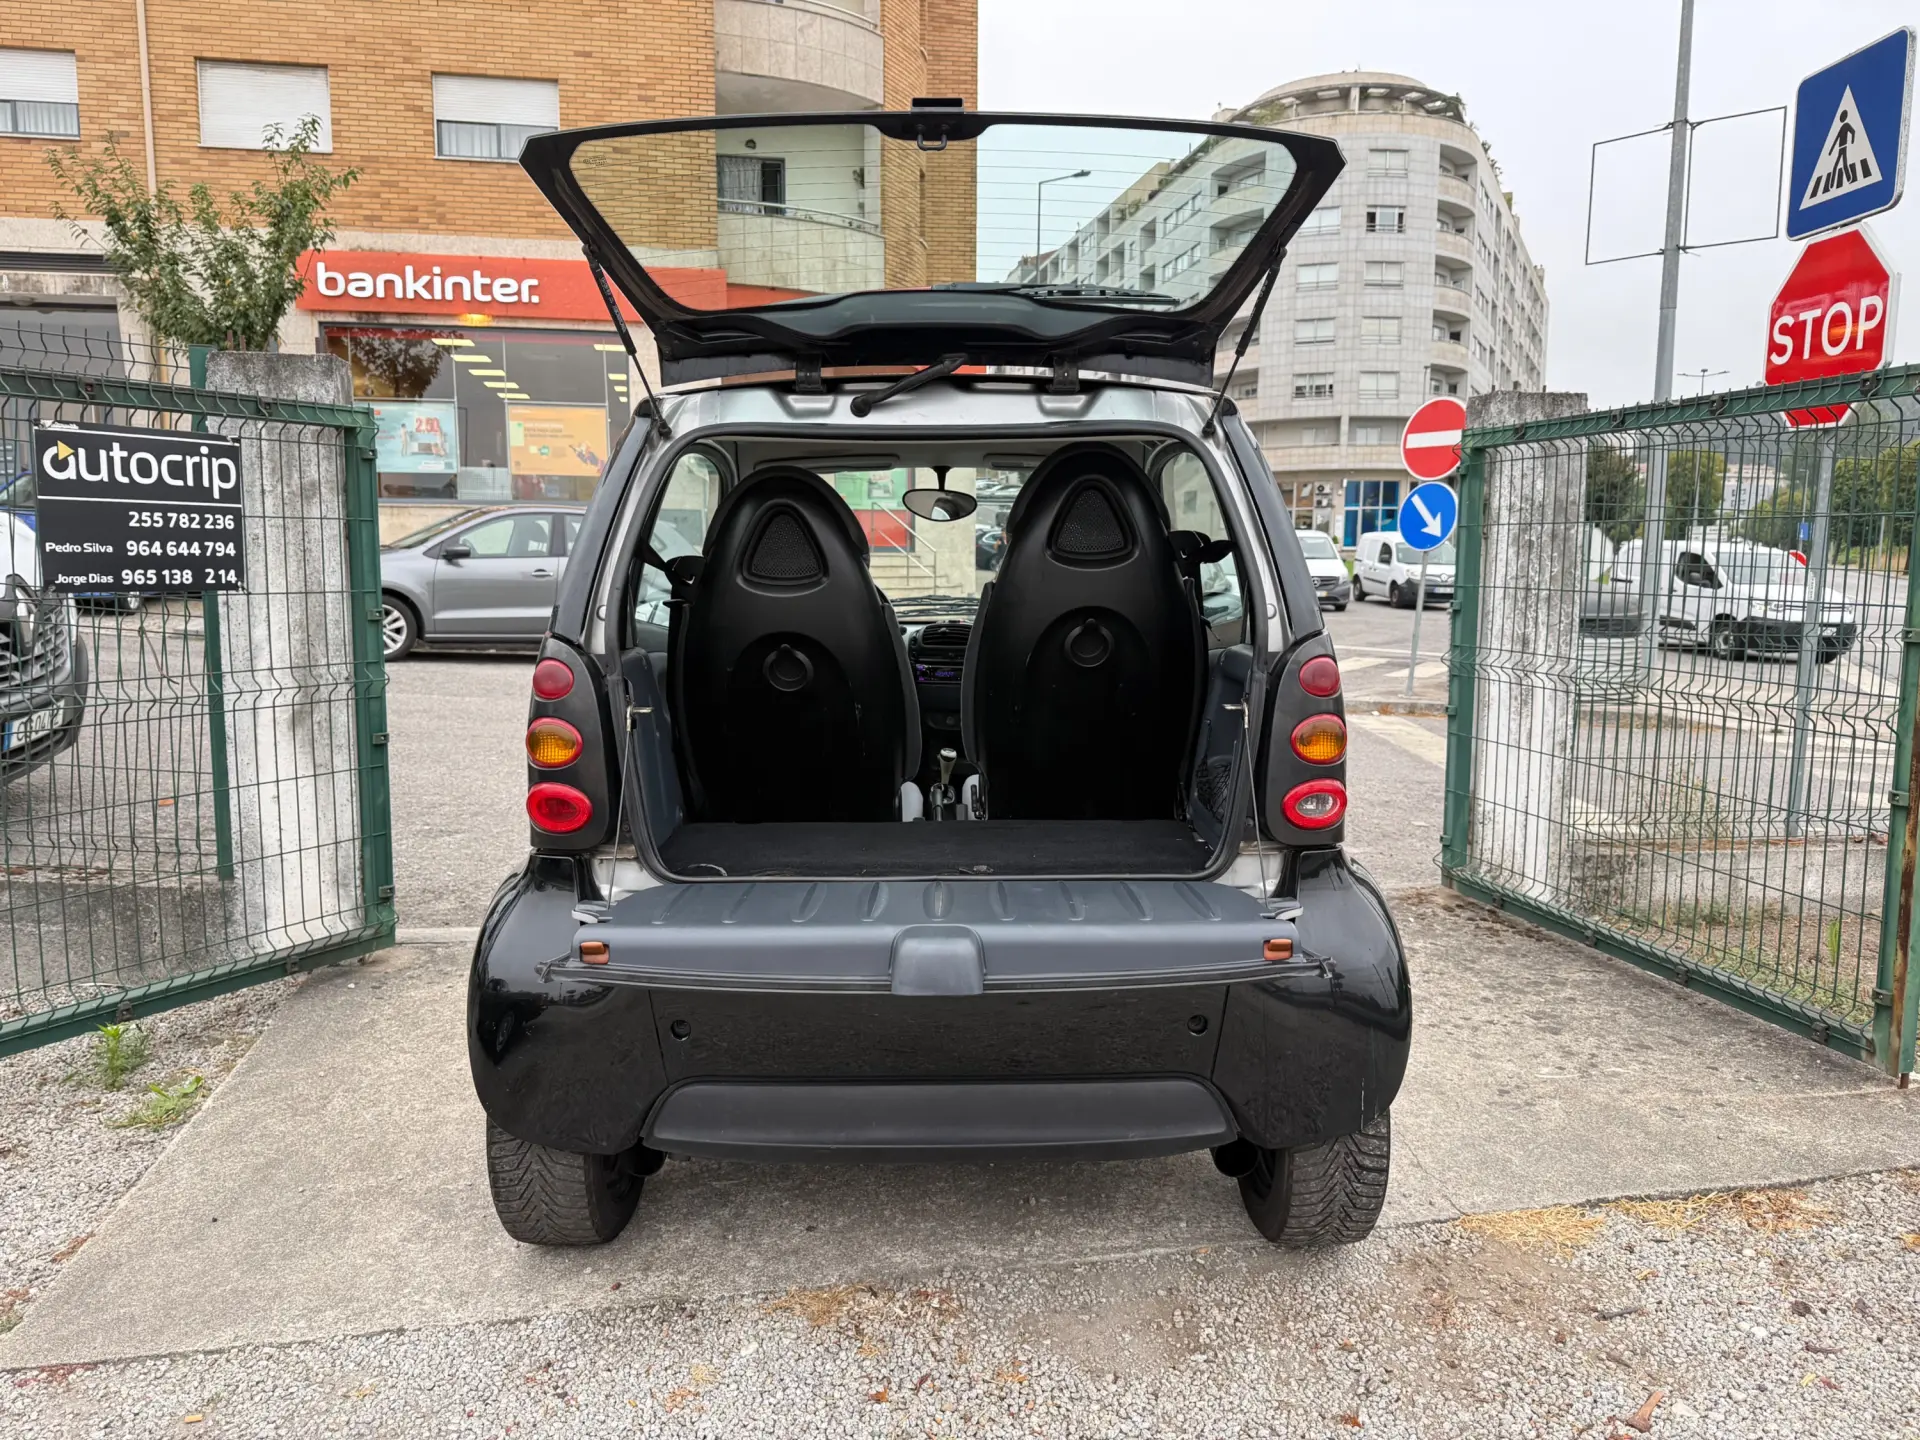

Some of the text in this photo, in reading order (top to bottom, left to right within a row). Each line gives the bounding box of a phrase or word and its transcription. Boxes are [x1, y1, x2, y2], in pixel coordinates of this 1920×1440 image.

[1769, 295, 1884, 366] STOP
[42, 440, 237, 499] autocrip
[128, 511, 235, 529] 255 782 236
[45, 540, 236, 557] Pedro Silva 964 644 794
[54, 568, 238, 586] Jorge Dias 965 138 214
